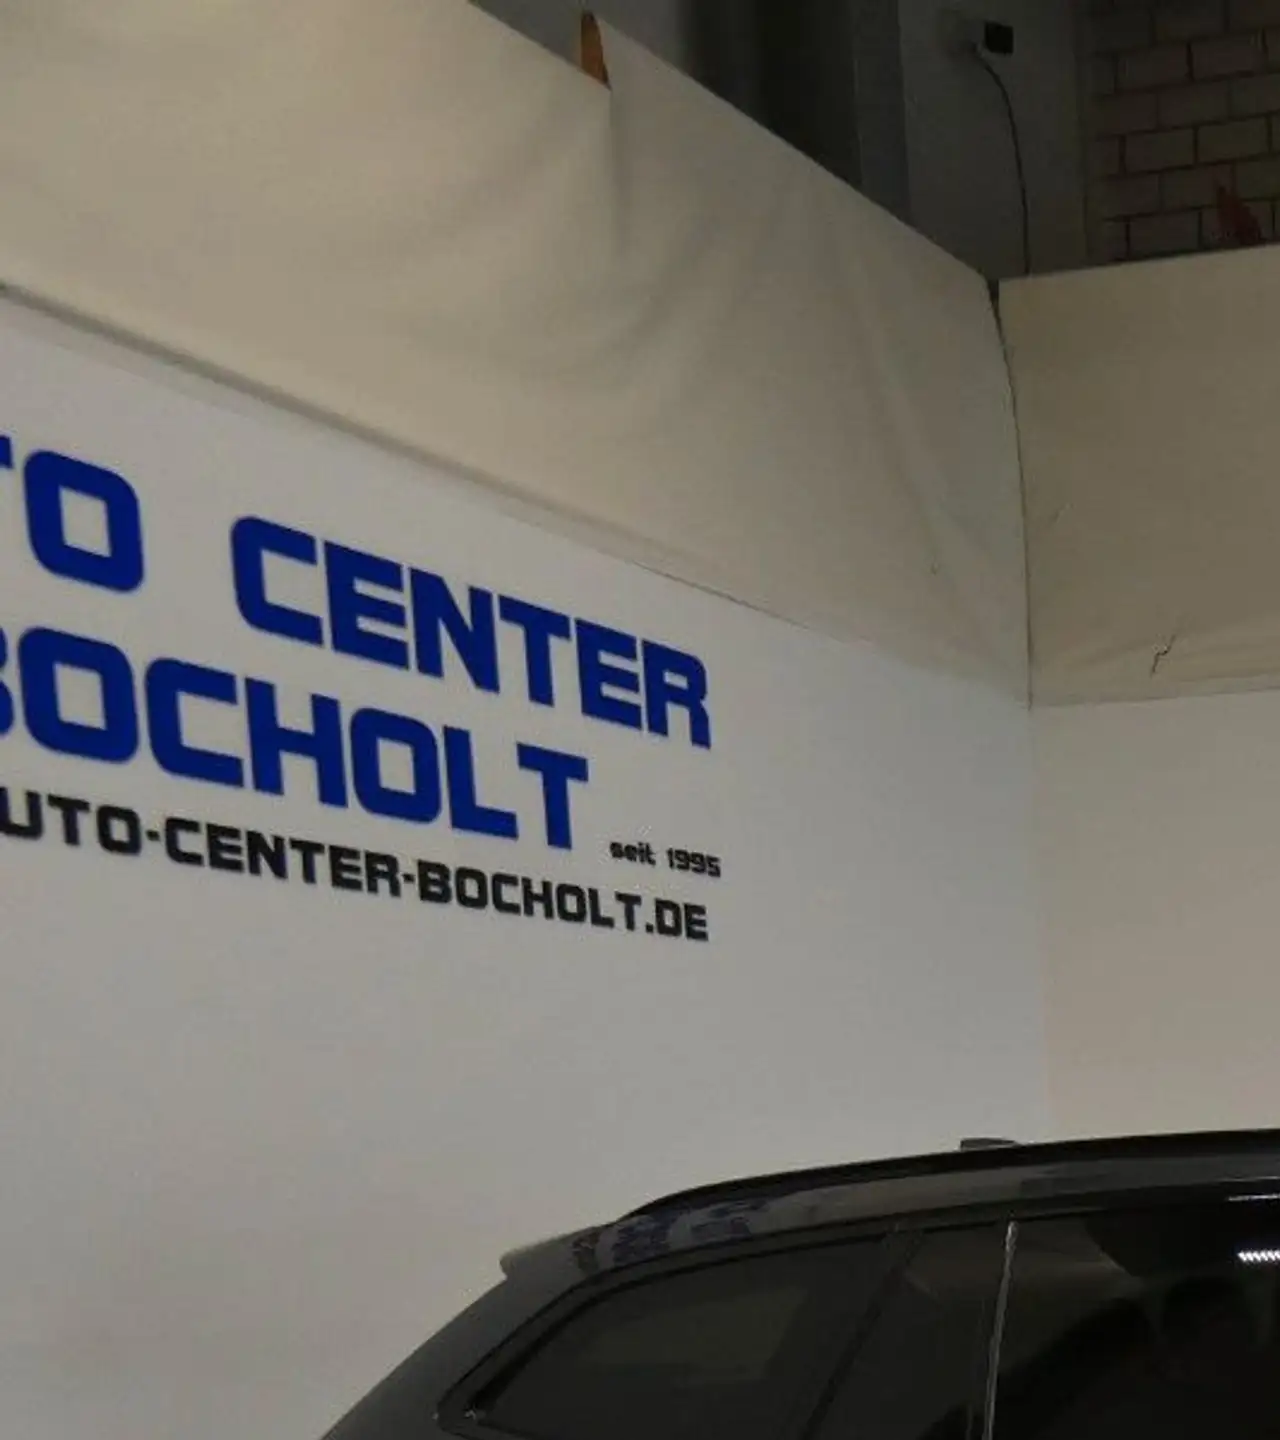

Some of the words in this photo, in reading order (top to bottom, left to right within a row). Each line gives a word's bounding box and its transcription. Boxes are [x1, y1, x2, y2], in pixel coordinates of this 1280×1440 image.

[0, 434, 144, 593] O
[231, 516, 711, 749] CENTER
[0, 626, 589, 850] OCHOLT
[609, 841, 657, 867] seit
[666, 847, 722, 878] 1995
